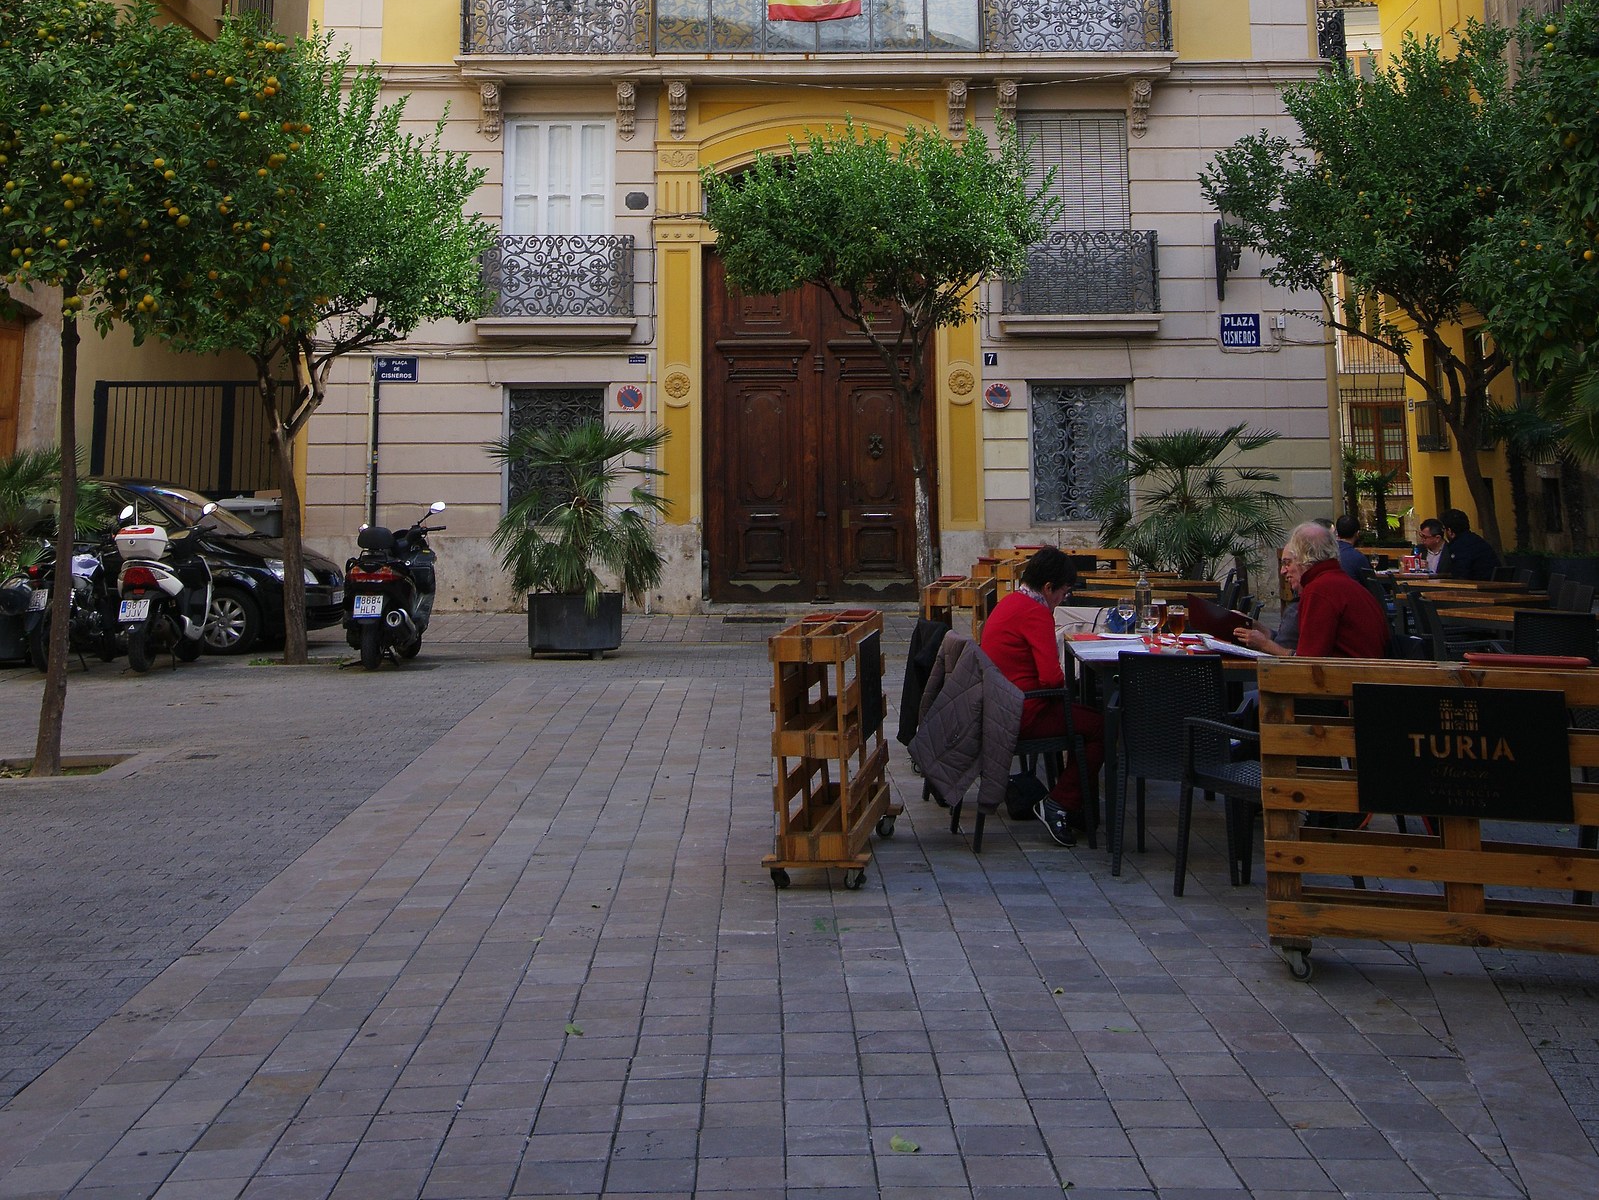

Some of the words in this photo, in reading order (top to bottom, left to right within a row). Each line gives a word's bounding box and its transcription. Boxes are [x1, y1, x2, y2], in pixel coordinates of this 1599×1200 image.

[1224, 316, 1255, 327] PLAZA
[1223, 330, 1256, 344] CISNEROS
[988, 354, 994, 365] 7
[126, 601, 148, 609] 9817
[361, 596, 381, 604] 8684
[126, 609, 142, 617] JJV
[1408, 732, 1516, 763] TURIA
